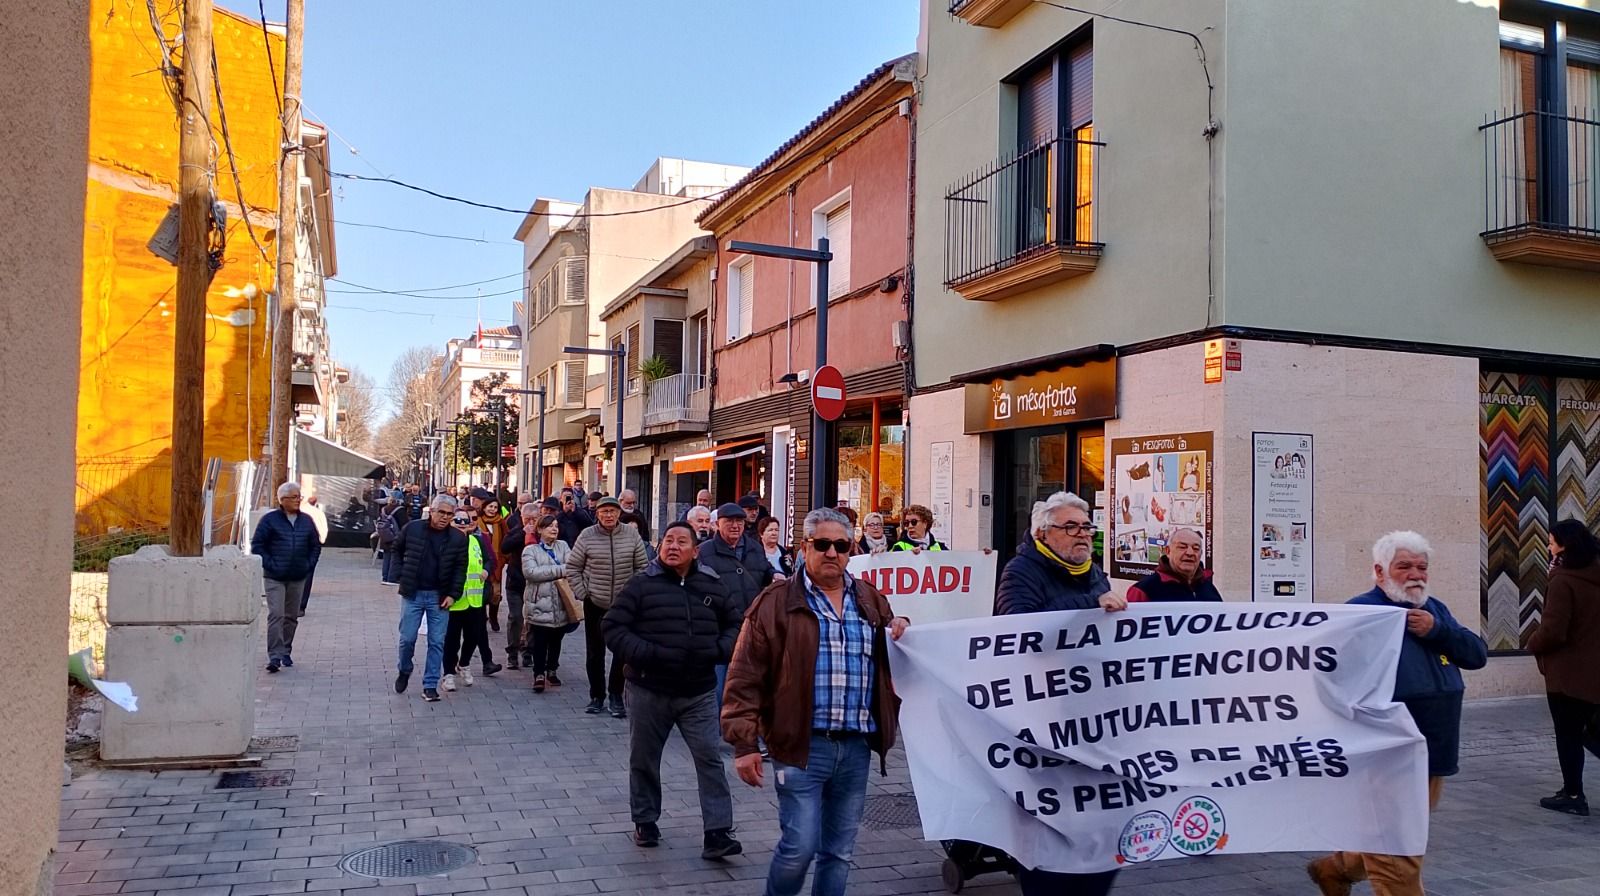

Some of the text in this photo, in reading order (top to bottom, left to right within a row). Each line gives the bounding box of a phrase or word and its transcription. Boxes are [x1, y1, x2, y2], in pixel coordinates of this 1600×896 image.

[1480, 392, 1537, 406] MARCATS
[969, 631, 1044, 660] PER
[1056, 624, 1102, 650] LA
[966, 645, 1338, 710] DE LES RETENCIONS
[1048, 694, 1299, 750] MUTUALITATS
